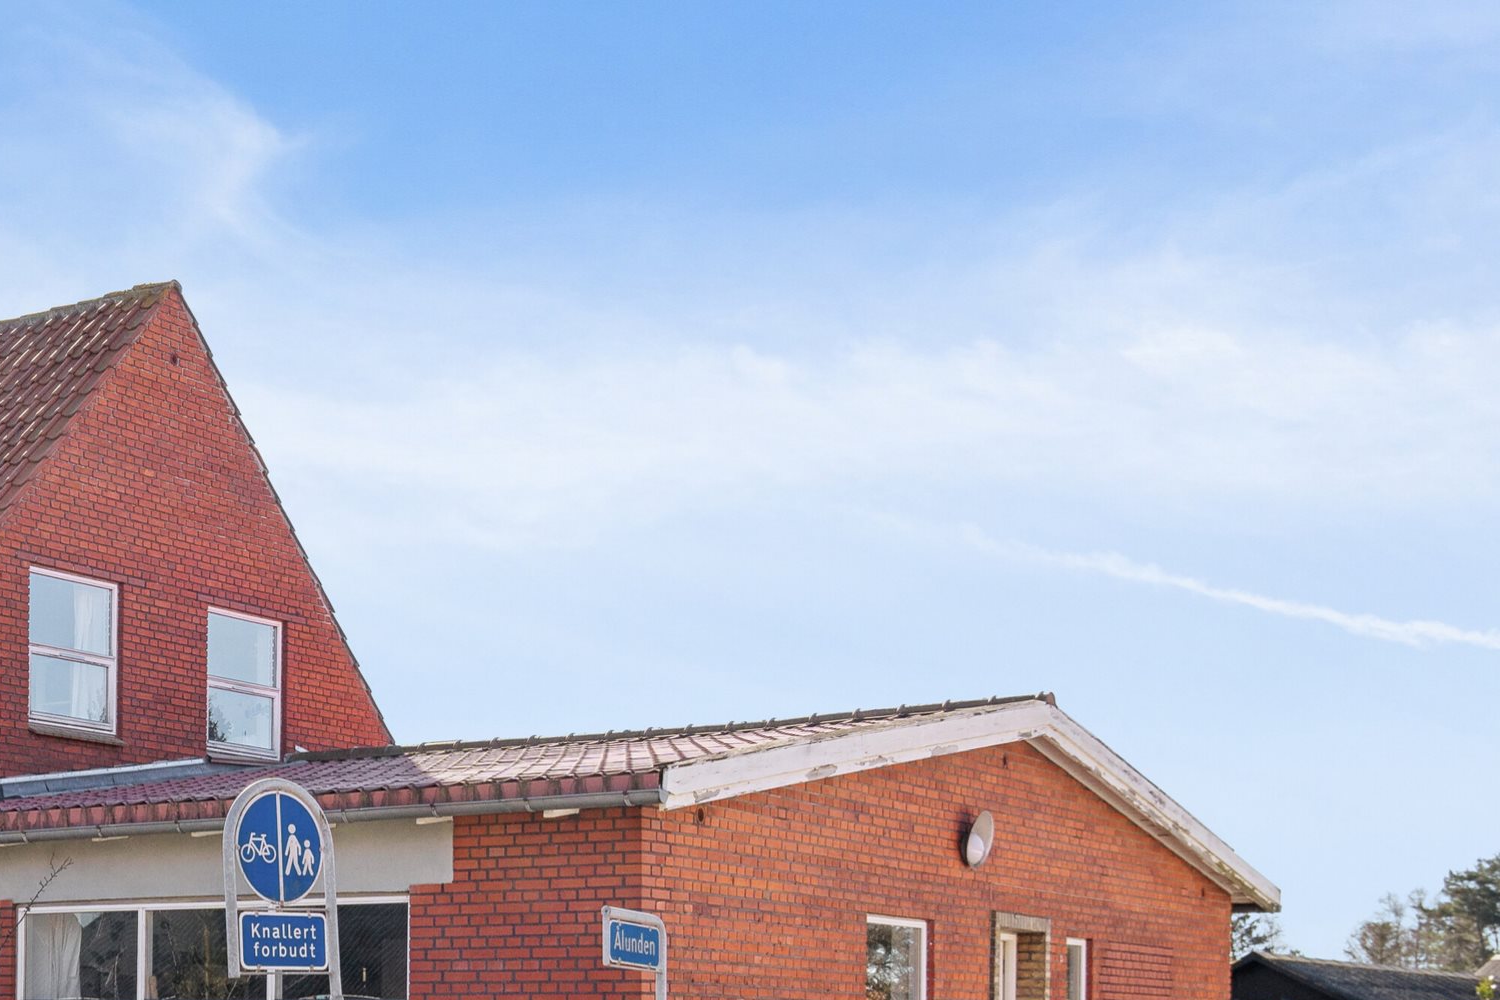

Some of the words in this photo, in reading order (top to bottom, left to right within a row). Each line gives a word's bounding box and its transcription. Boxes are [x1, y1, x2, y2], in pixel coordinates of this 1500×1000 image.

[251, 922, 317, 940] Knallert
[253, 941, 316, 958] forbudt
[613, 925, 656, 956] Ålunden
